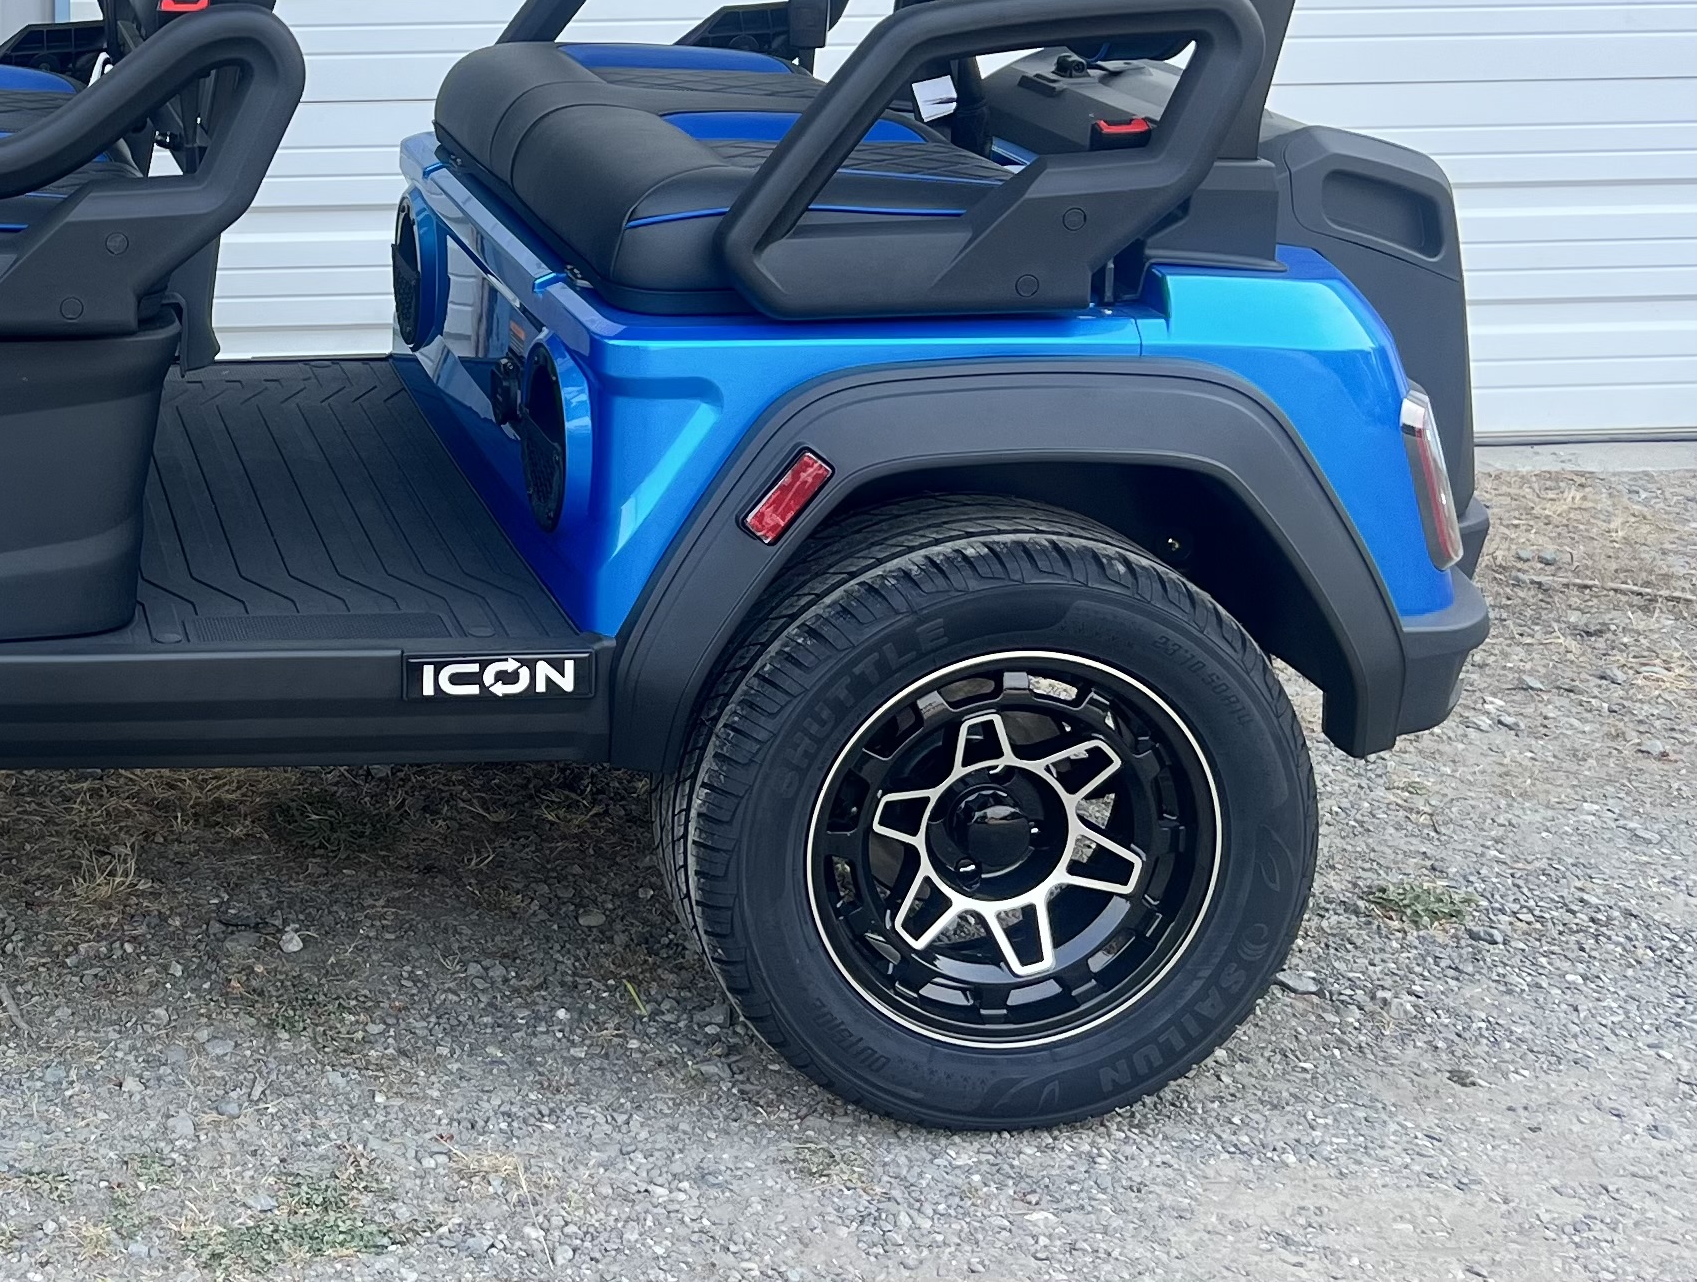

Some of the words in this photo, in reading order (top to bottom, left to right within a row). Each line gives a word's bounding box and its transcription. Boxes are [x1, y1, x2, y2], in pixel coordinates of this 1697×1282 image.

[422, 657, 574, 697] ICON
[775, 617, 950, 800] SHUTTLE
[1095, 960, 1250, 1092] SAILUN
